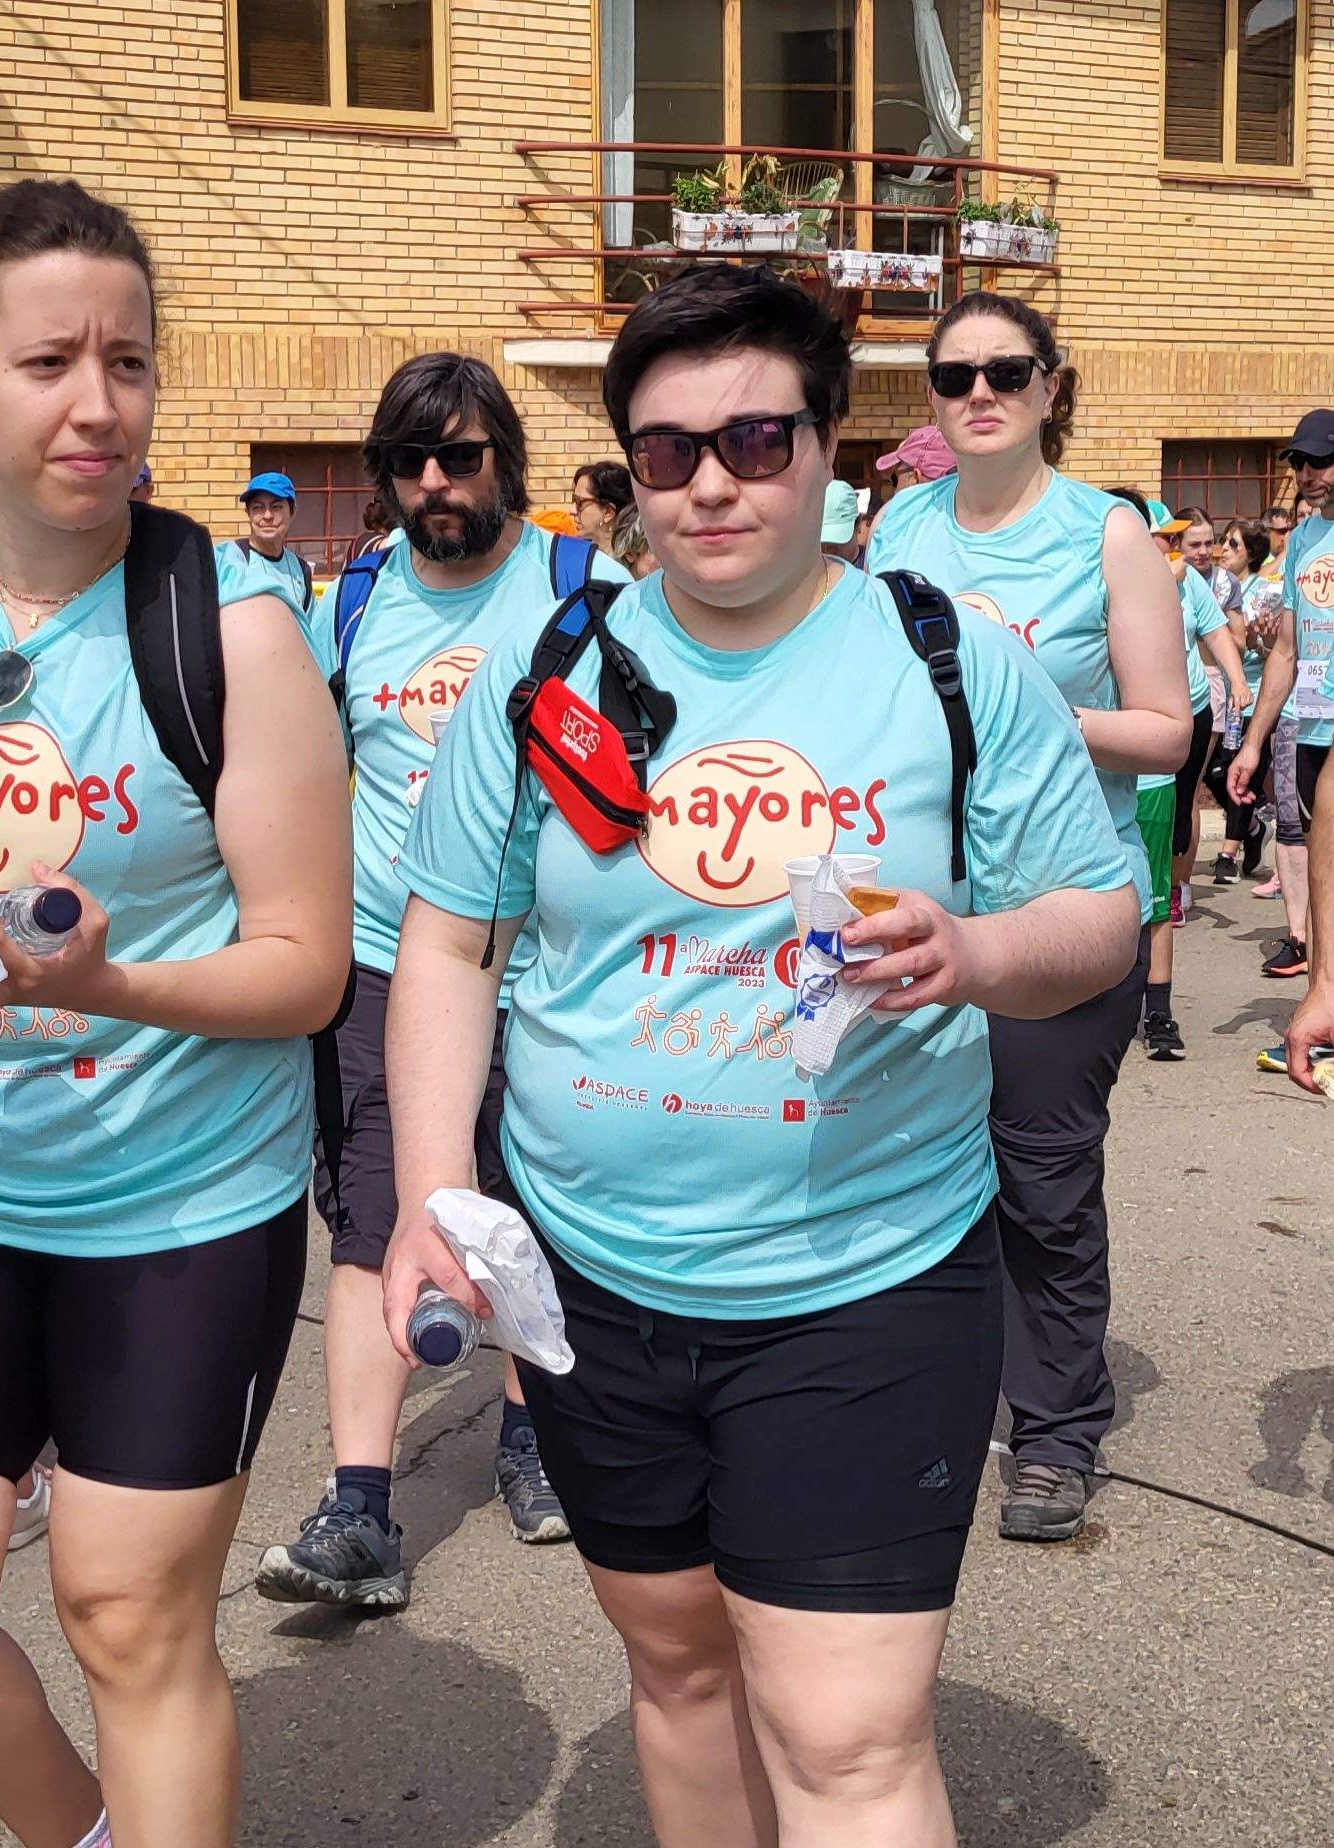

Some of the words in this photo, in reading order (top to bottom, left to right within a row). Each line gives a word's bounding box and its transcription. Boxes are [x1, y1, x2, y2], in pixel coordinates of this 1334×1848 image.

[1308, 664, 1329, 676] 065
[689, 936, 769, 965] Marcha
[724, 965, 766, 978] HUESCA
[738, 978, 765, 988] 2023
[685, 1099, 713, 1113] hoya
